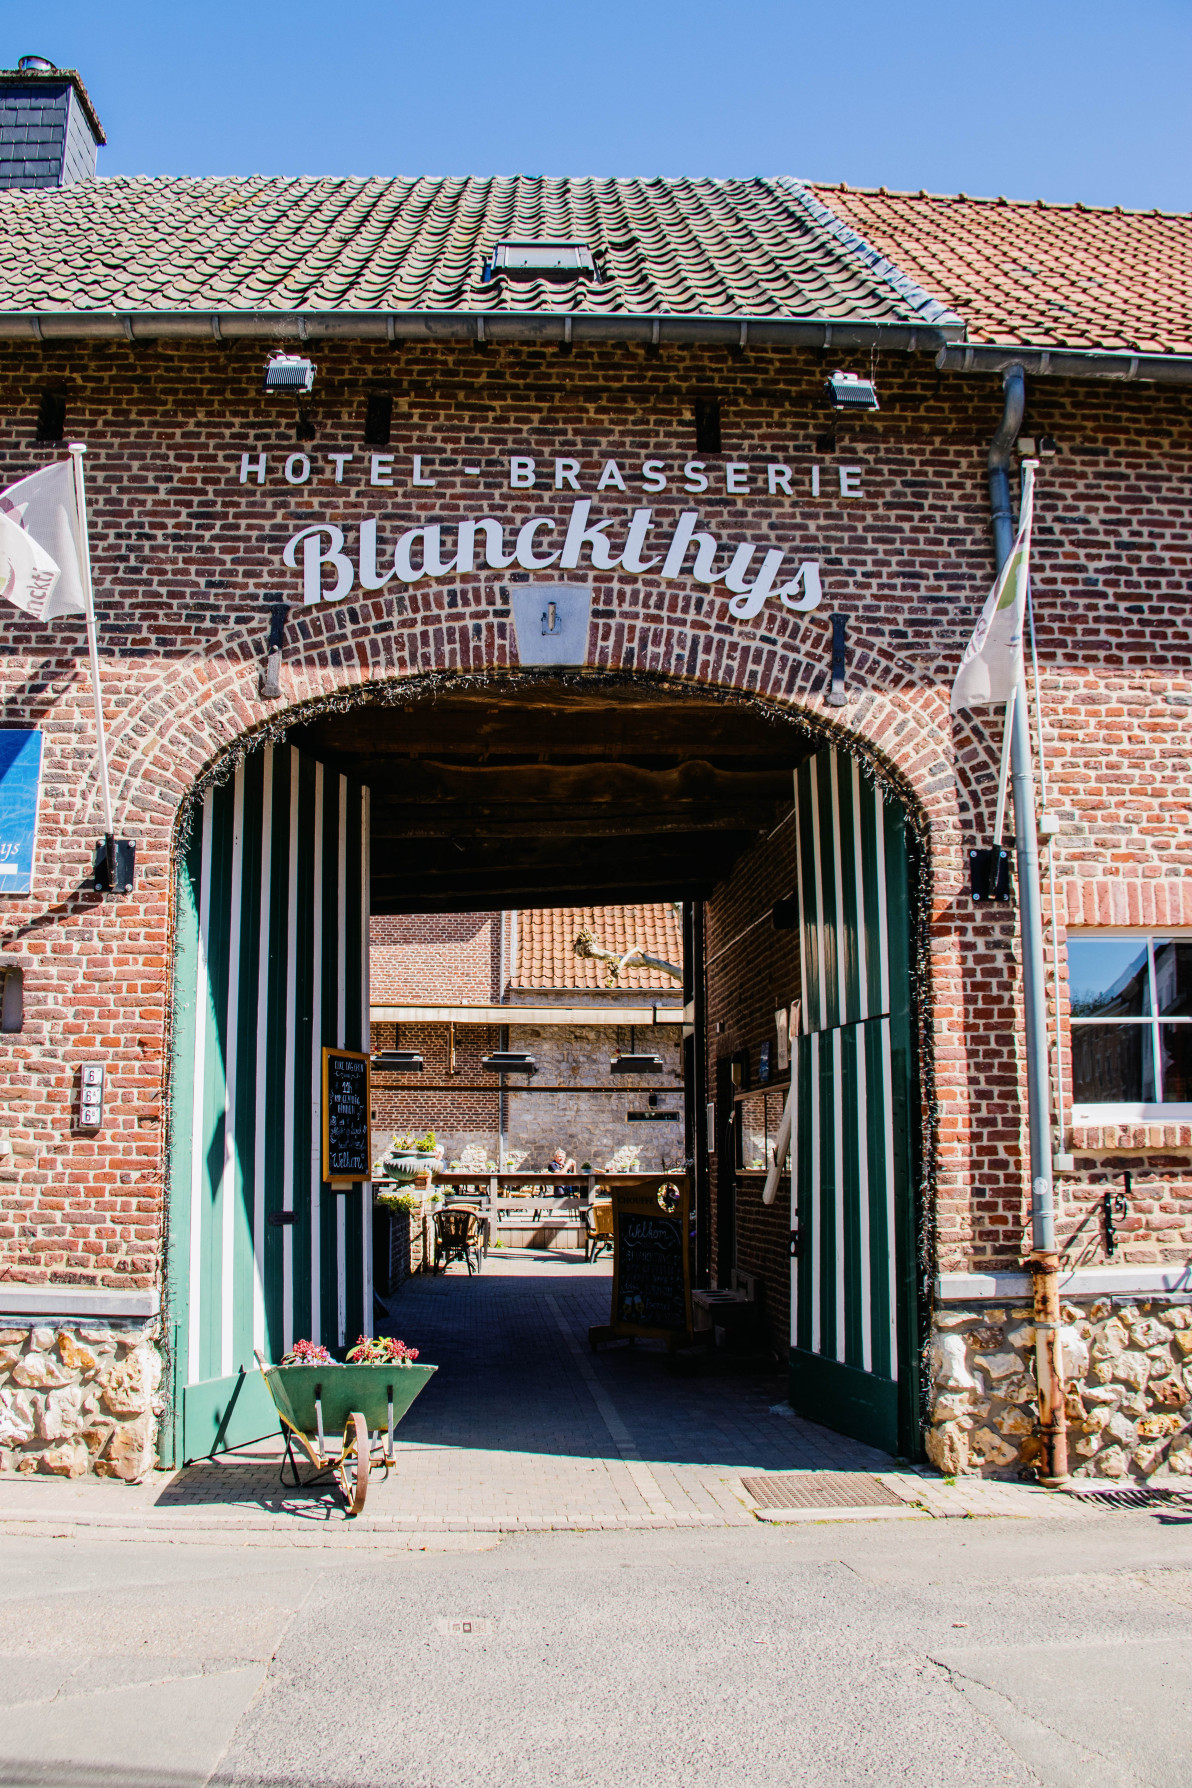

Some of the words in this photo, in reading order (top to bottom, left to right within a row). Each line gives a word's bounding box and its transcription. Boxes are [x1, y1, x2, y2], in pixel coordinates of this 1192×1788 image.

[239, 453, 436, 487] HOTEL
[510, 456, 864, 498] BRASSERIE
[283, 500, 823, 620] Blanckthys
[89, 1070, 95, 1081] 6
[628, 1220, 667, 1239] Welkom
